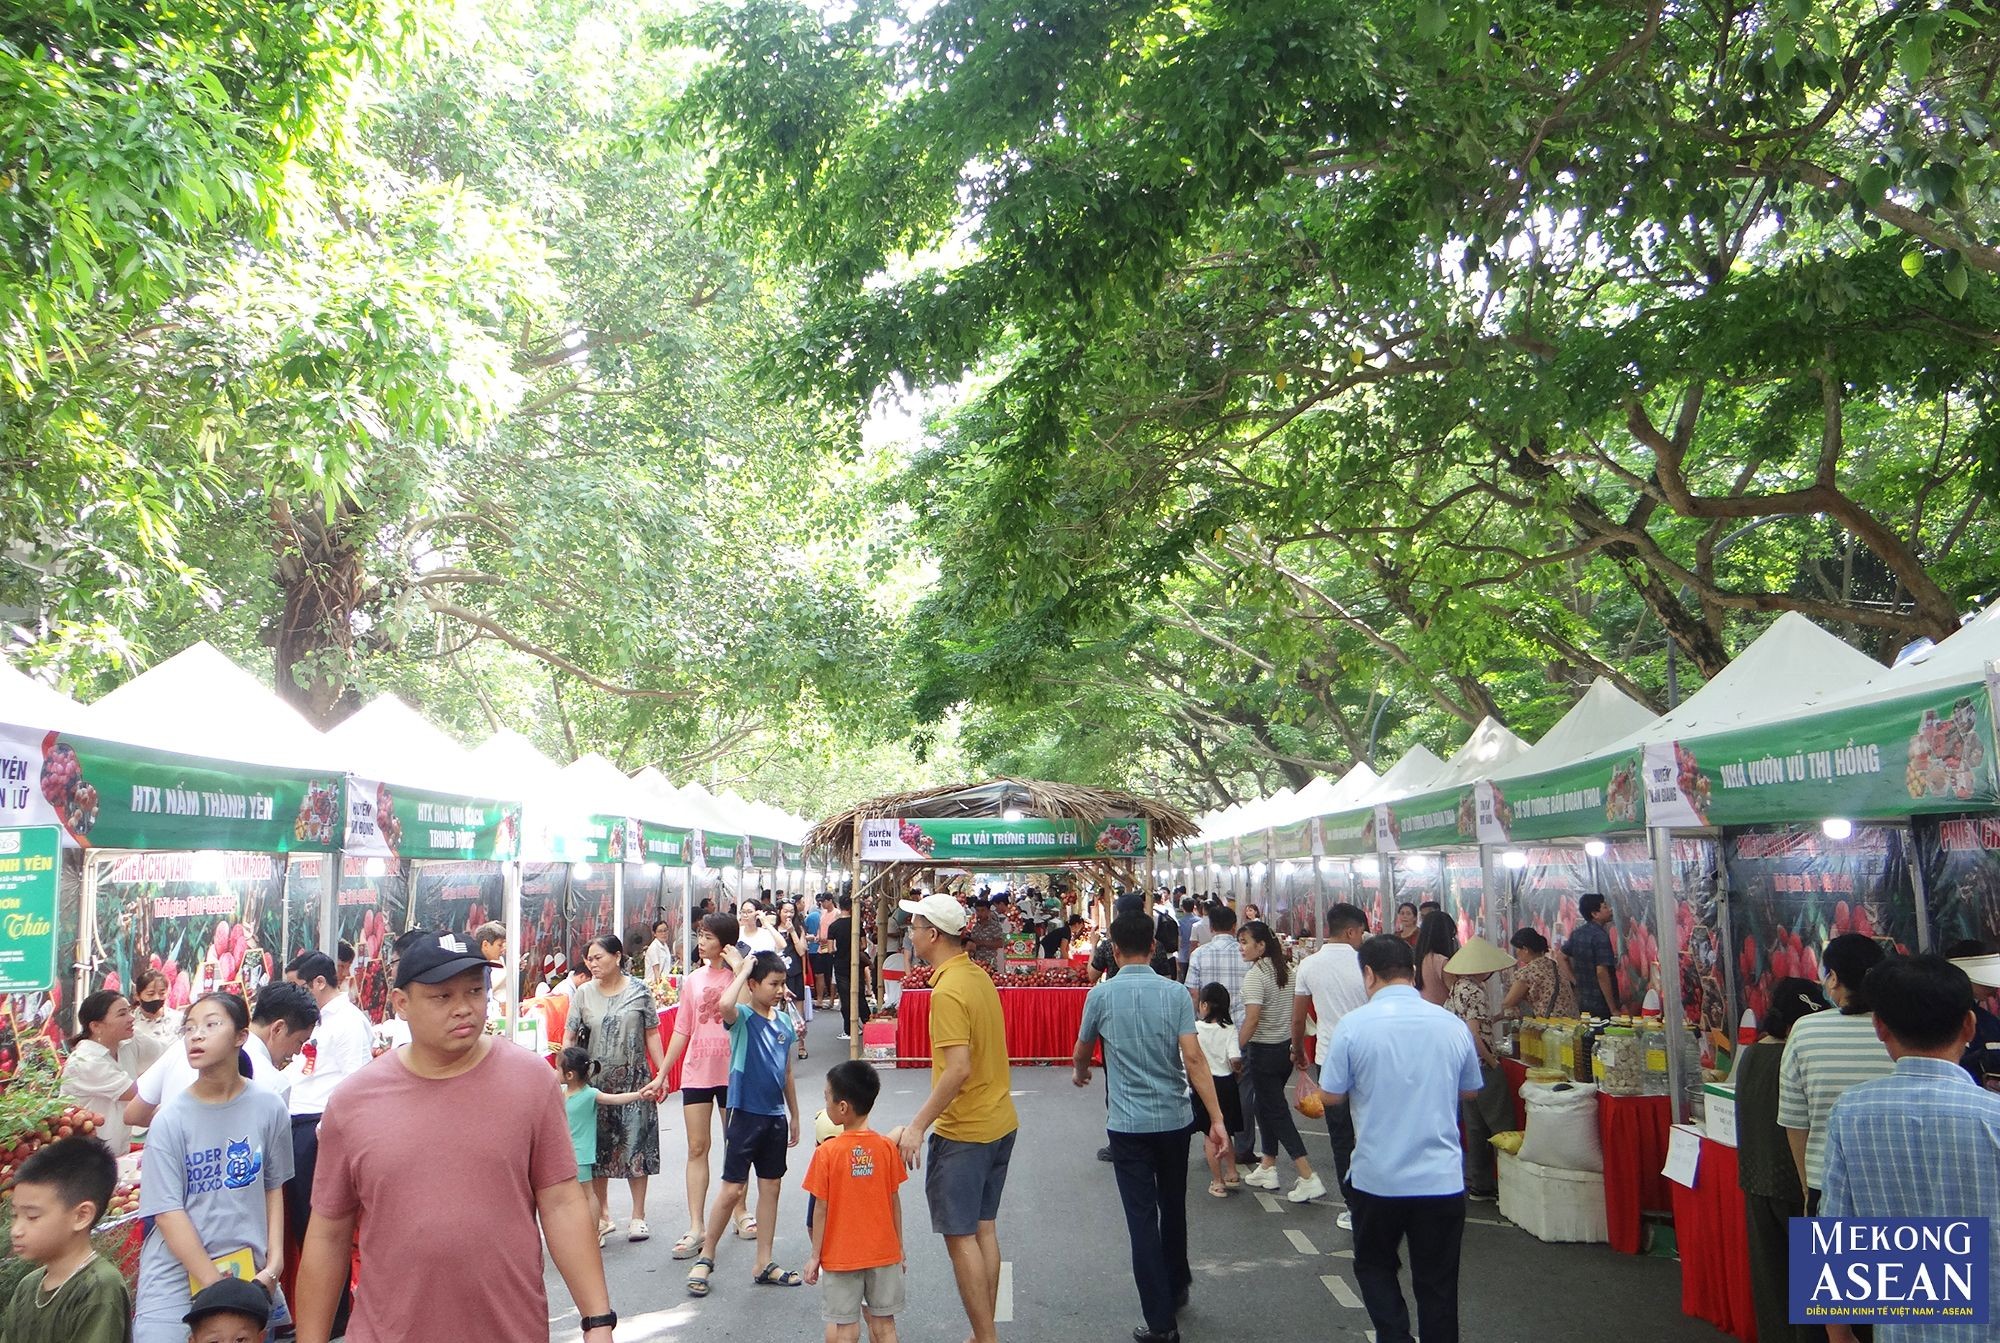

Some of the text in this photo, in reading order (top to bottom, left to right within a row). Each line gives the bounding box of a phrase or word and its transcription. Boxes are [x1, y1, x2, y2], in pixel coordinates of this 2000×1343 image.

[1720, 738, 1880, 789] NHÀ VƯỜN VŨ THỊ HỒNG
[131, 785, 161, 813] HTX
[202, 789, 246, 818] THÀNH
[248, 792, 273, 820] YÊN
[951, 829, 1077, 845] HTX VẢI TRỨNG HƯNG YÊN
[24, 855, 52, 871] YÊN
[186, 1148, 222, 1167] ADER
[187, 1164, 222, 1182] 2024
